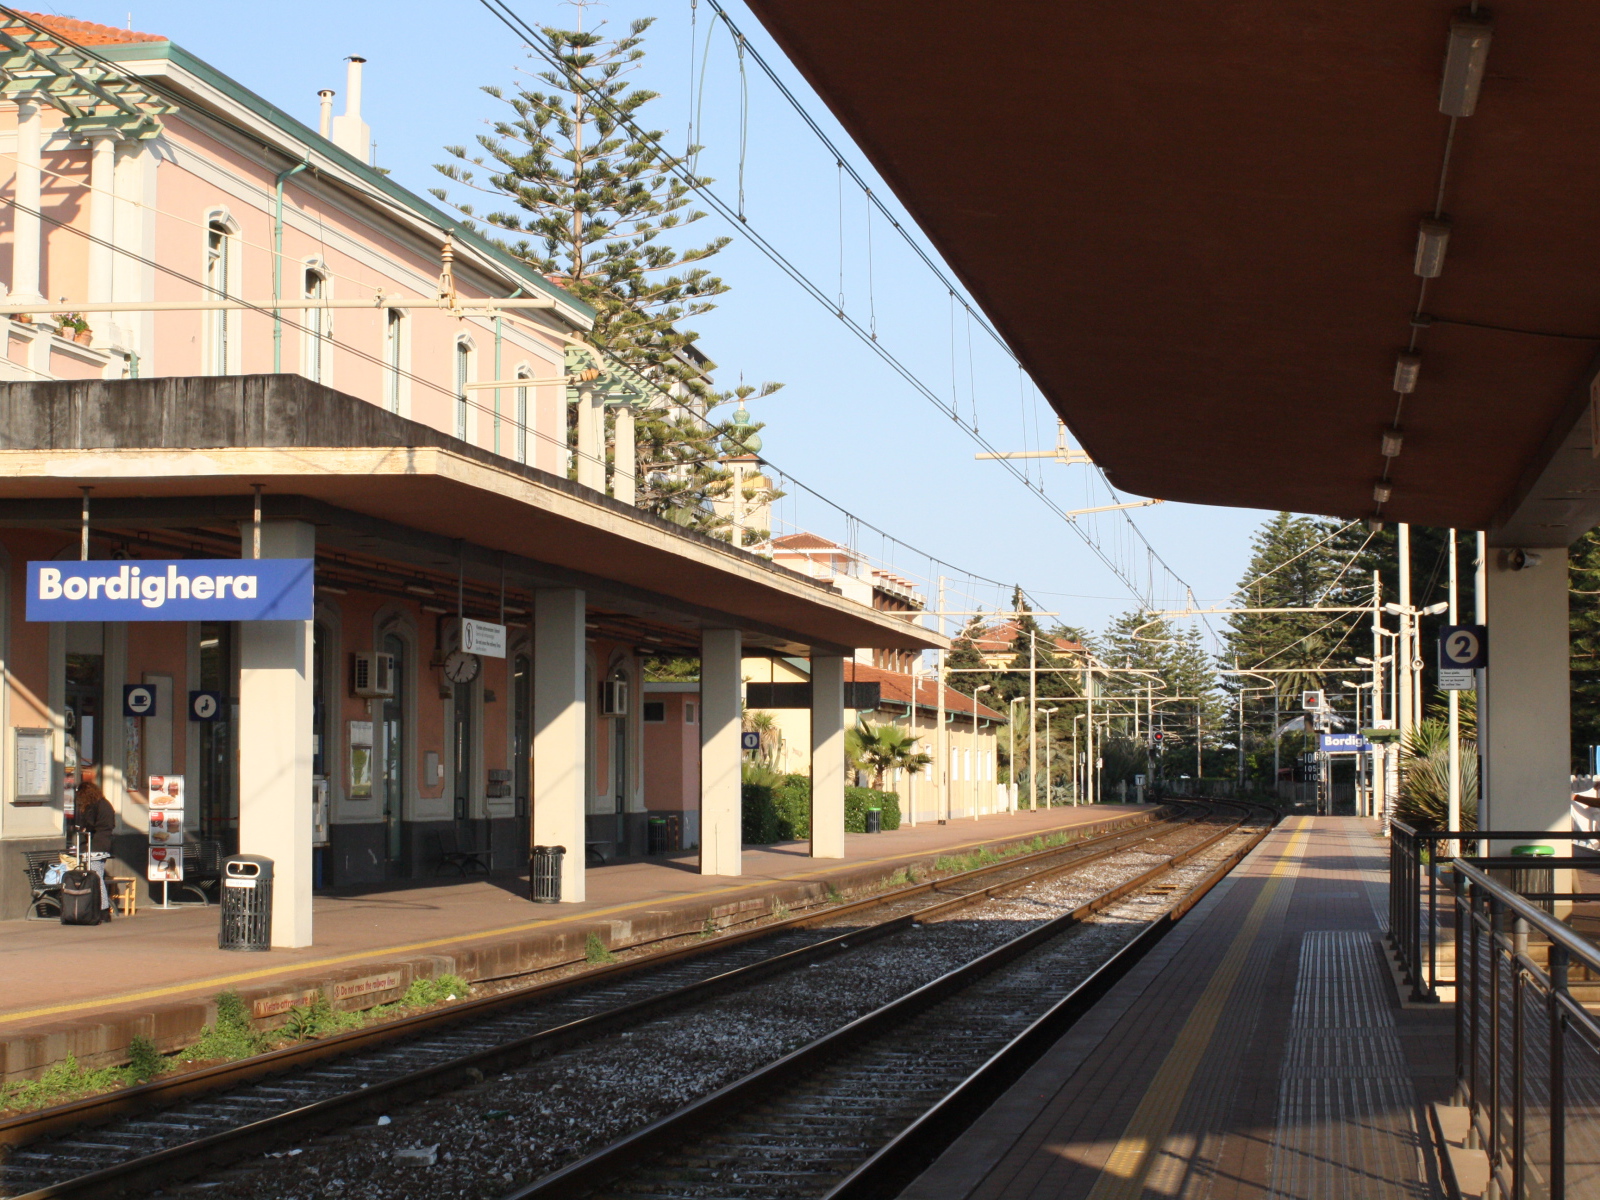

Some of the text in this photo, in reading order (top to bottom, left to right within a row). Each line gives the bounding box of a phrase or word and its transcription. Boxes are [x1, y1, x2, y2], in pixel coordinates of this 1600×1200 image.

[39, 565, 257, 608] Bordighera
[1454, 636, 1471, 657] 2
[748, 736, 753, 745] 1
[1136, 776, 1142, 784] T
[341, 985, 347, 996] Do
